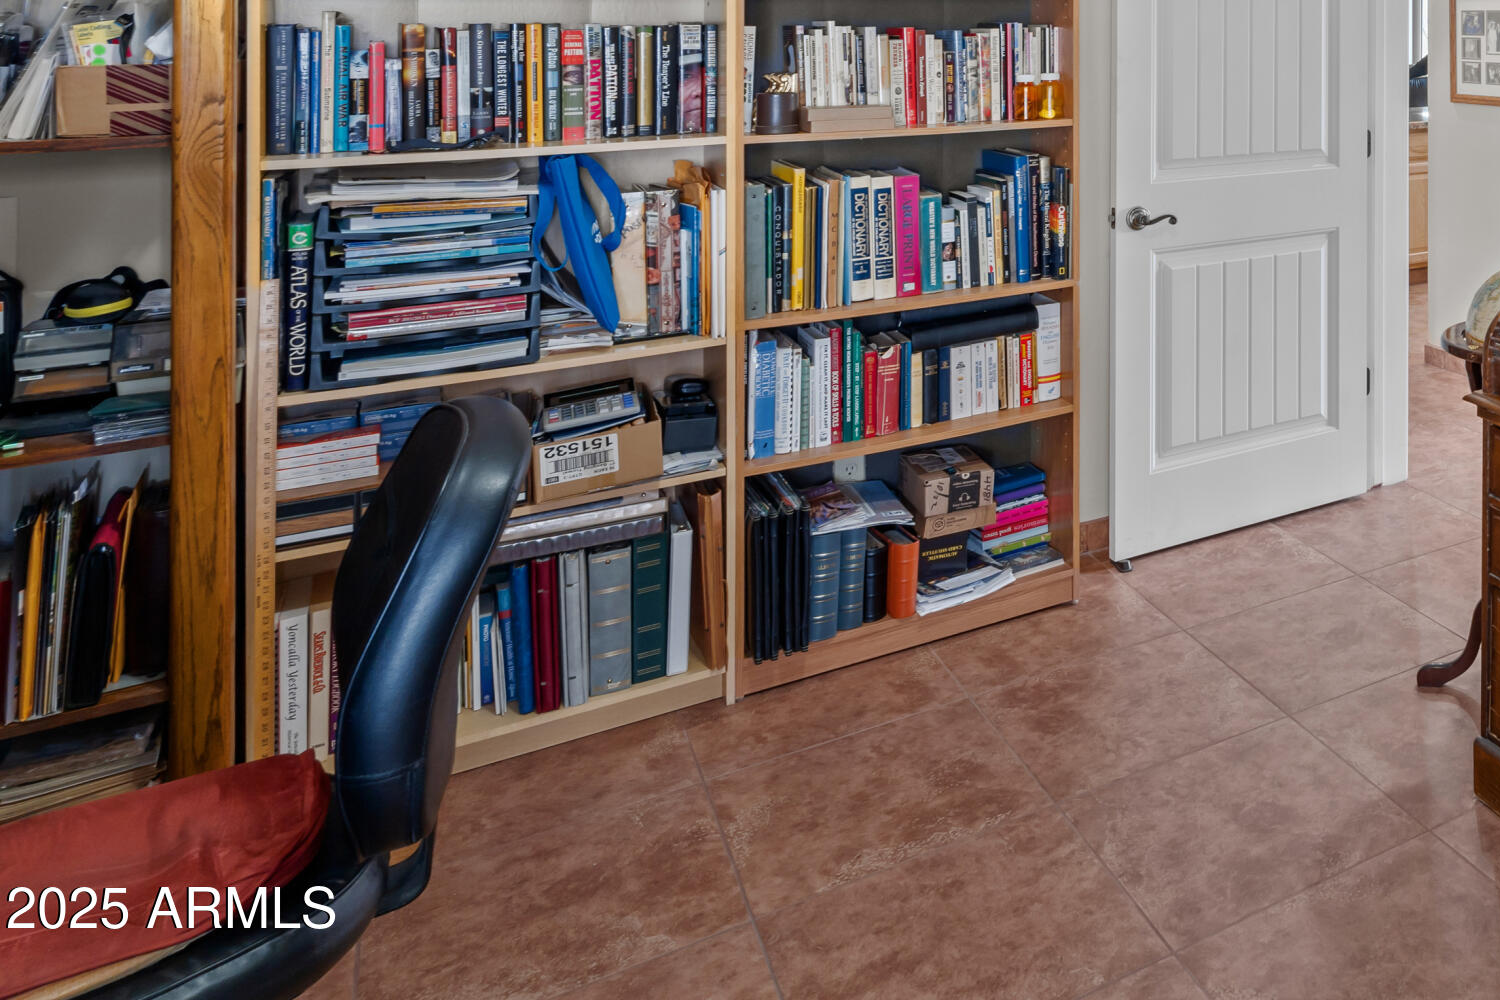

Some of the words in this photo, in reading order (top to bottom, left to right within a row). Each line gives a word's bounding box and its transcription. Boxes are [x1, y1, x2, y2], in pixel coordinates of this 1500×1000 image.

[496, 40, 507, 54] THE
[547, 27, 558, 47] Killing
[324, 43, 332, 56] The
[548, 48, 557, 69] Patton
[564, 48, 583, 56] PATTON
[661, 44, 670, 58] The
[338, 46, 348, 80] NAVAL
[496, 56, 507, 87] LONGEST
[661, 60, 670, 89] Reaper's
[337, 83, 348, 100] AIR
[590, 59, 601, 120] PATTON
[606, 64, 617, 99] PATTON
[707, 86, 716, 95] JAY
[324, 87, 332, 120] Submarine
[496, 89, 507, 116] WINTER
[549, 89, 557, 100] BILL
[661, 91, 670, 106] Line
[707, 95, 716, 118] SEKULOW
[337, 103, 348, 127] WAR
[548, 100, 557, 120] O'REILLY
[1043, 189, 1051, 201] The
[903, 188, 913, 228] LARGE
[929, 202, 937, 228] WEBSTER'S
[1043, 201, 1051, 223] Mineral
[855, 193, 865, 257] DICTIONARY
[879, 193, 889, 256] DICTIONARY
[929, 228, 937, 239] NEW
[1043, 223, 1051, 249] Kingdom
[903, 234, 913, 272] PRINT
[929, 240, 937, 257] WORLD
[929, 258, 937, 286] DICTIONARY
[290, 266, 306, 308] ATLAS
[289, 322, 305, 377] WORLD
[762, 353, 771, 395] DIABETIC
[832, 370, 840, 384] BOOK
[832, 391, 840, 407] SKILLS
[832, 412, 840, 427] TOOLS
[544, 435, 612, 459] 151532
[286, 624, 300, 668] Yoncalla
[286, 669, 300, 721] Yesterday
